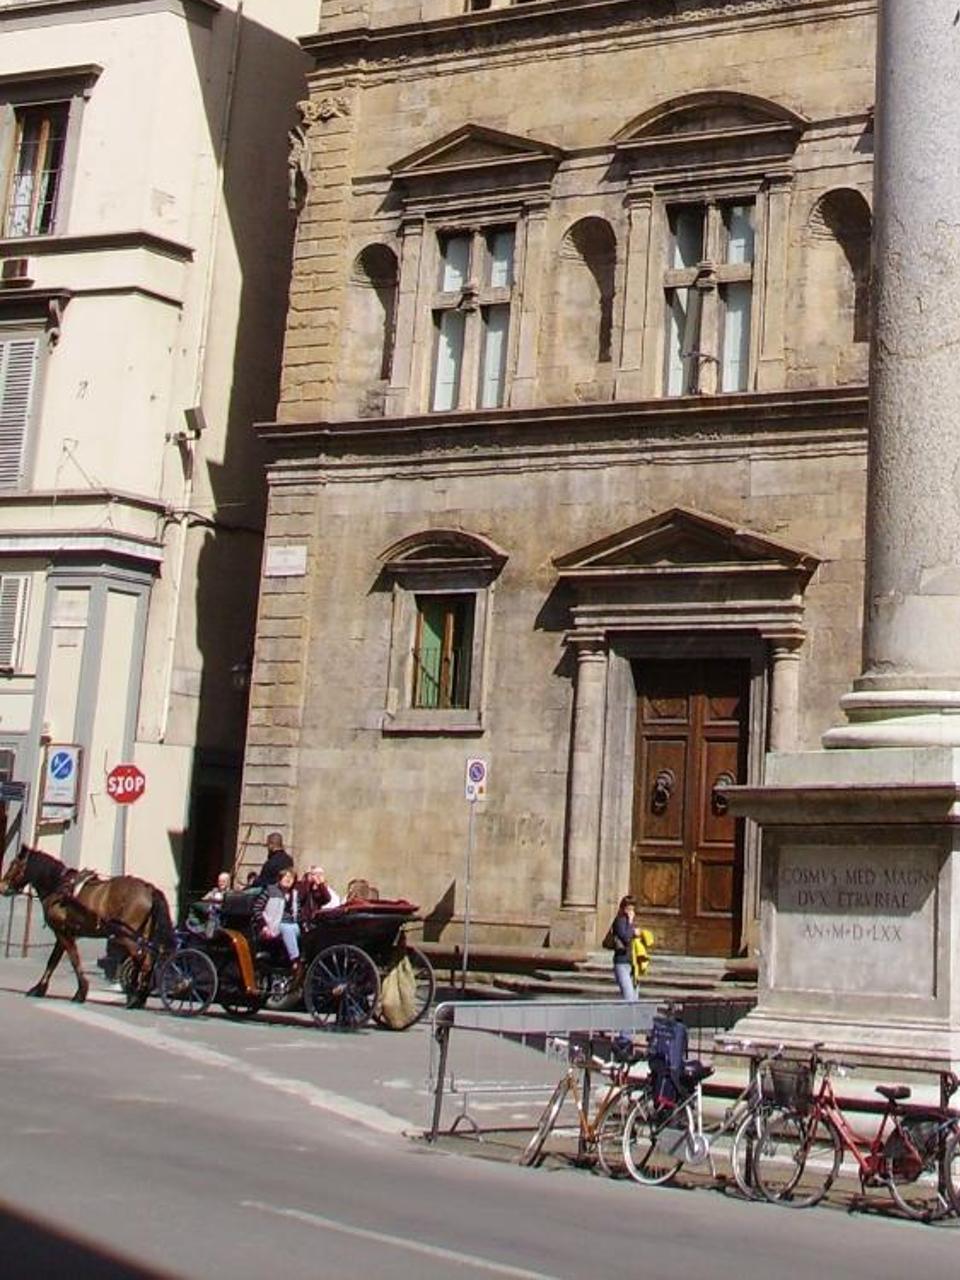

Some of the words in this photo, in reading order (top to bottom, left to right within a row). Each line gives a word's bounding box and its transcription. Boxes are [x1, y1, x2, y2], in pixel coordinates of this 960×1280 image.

[108, 775, 145, 794] STOP
[782, 868, 838, 886] COSMVS
[846, 869, 877, 885] MED
[797, 891, 829, 908] DVX
